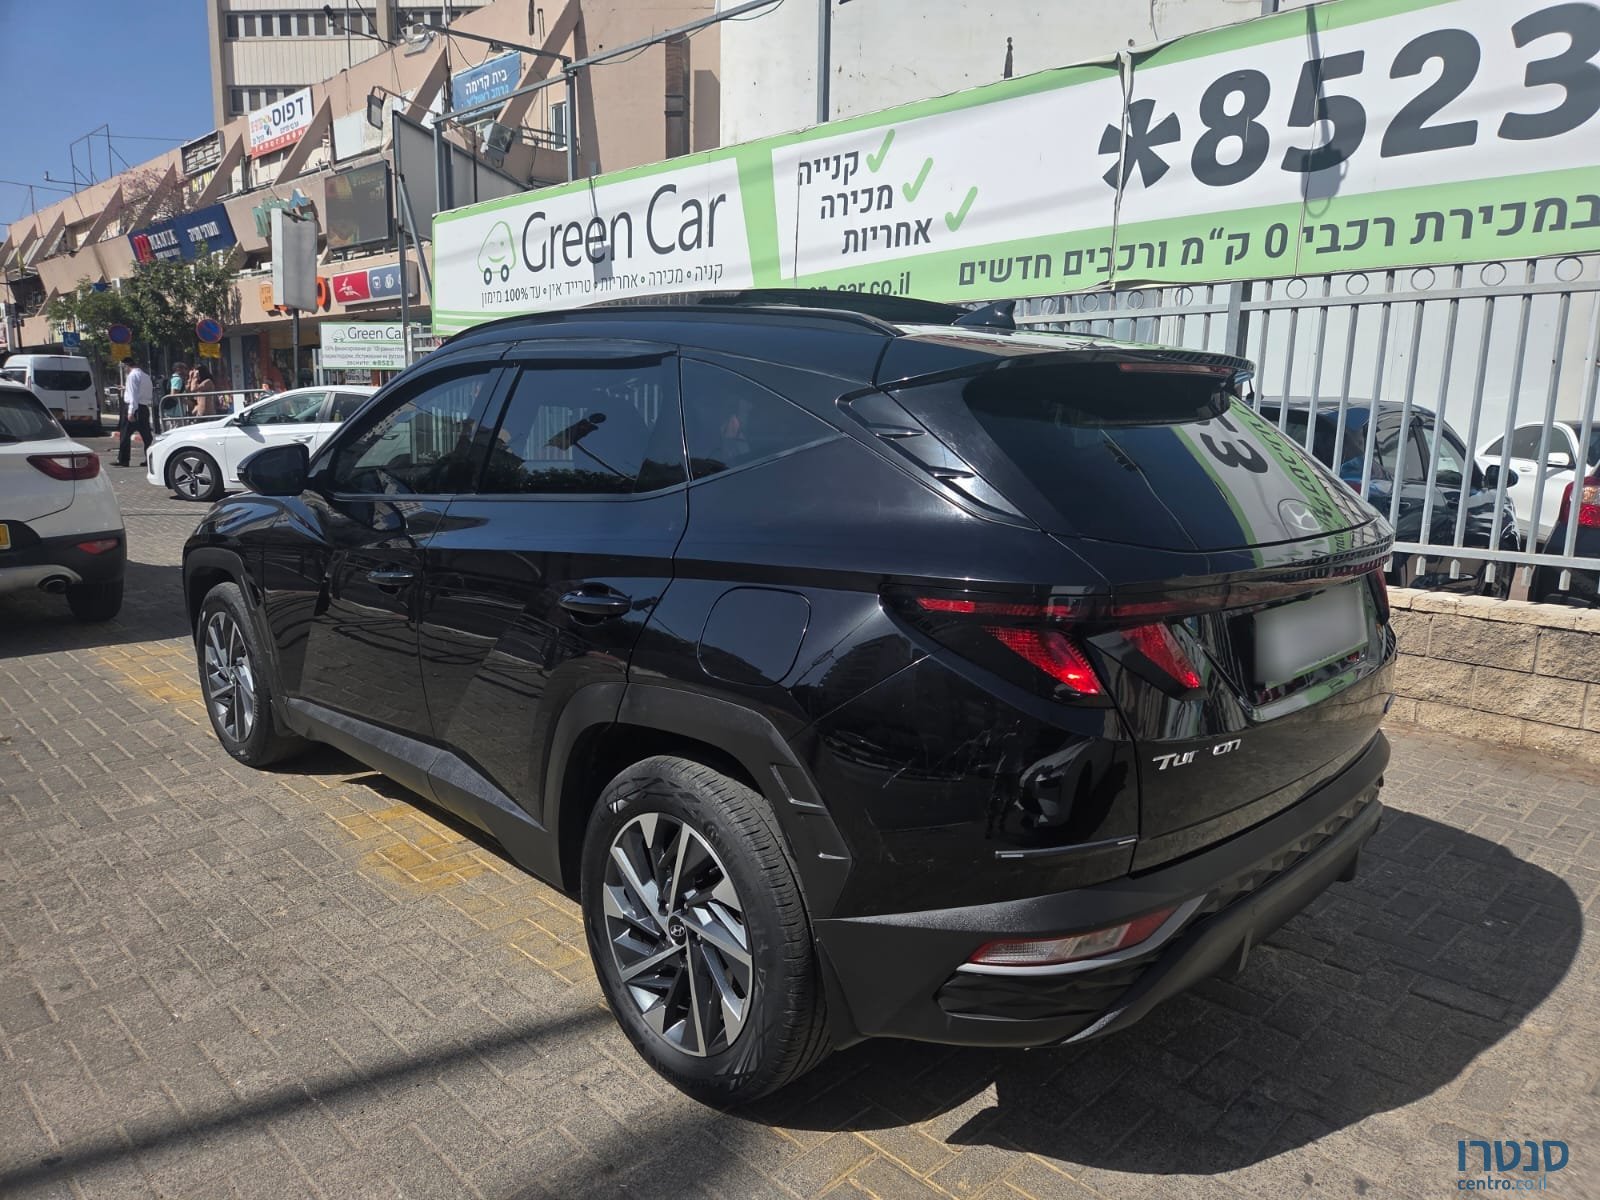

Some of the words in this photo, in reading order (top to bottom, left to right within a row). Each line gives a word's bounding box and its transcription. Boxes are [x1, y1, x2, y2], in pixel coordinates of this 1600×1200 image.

[272, 97, 304, 126] דפוס
[799, 150, 859, 186] קנייה
[820, 184, 893, 219] מכירה
[522, 211, 632, 272] Green
[646, 183, 726, 255] Car
[1410, 193, 1600, 245] במכירת
[841, 217, 933, 255] אחריות
[1264, 222, 1289, 259] 0
[1302, 215, 1396, 255] רכבי
[958, 253, 1052, 286] חדשים
[1063, 240, 1169, 277] ורכבים
[565, 278, 592, 294] טרייד
[600, 272, 639, 292] אחריות
[648, 268, 684, 287] מכירה
[694, 263, 723, 284] קניה
[481, 289, 502, 308] מימון
[505, 285, 529, 302] 100%
[529, 284, 541, 299] עד
[548, 283, 562, 301] אין
[347, 326, 383, 340] Green
